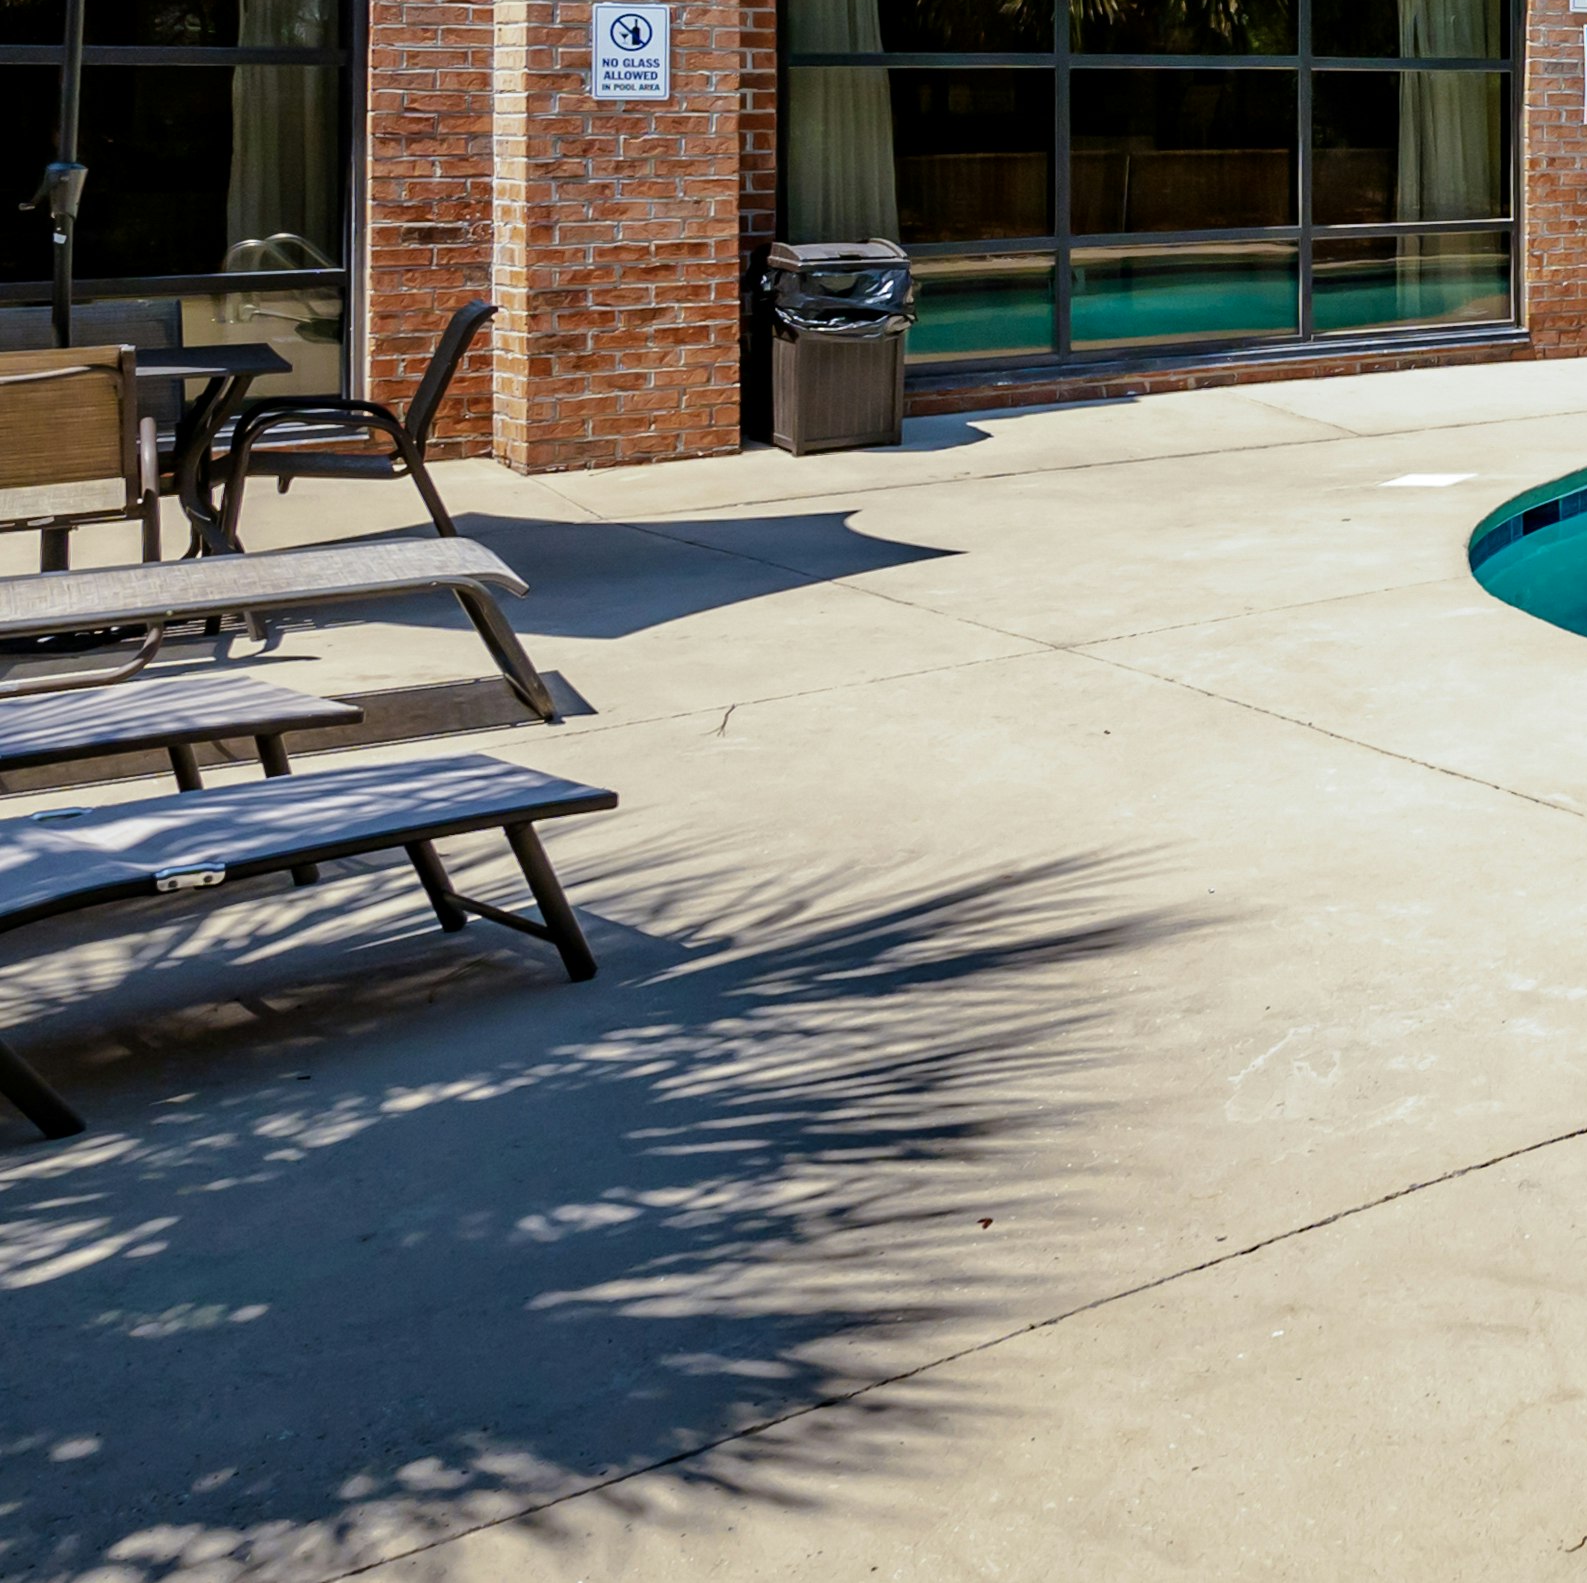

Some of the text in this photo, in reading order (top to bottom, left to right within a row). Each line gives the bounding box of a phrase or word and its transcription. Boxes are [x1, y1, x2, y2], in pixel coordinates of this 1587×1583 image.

[602, 58, 660, 68] NO GLASS
[603, 71, 658, 81] ALLOWED
[602, 83, 660, 91] IN POOL AREA
